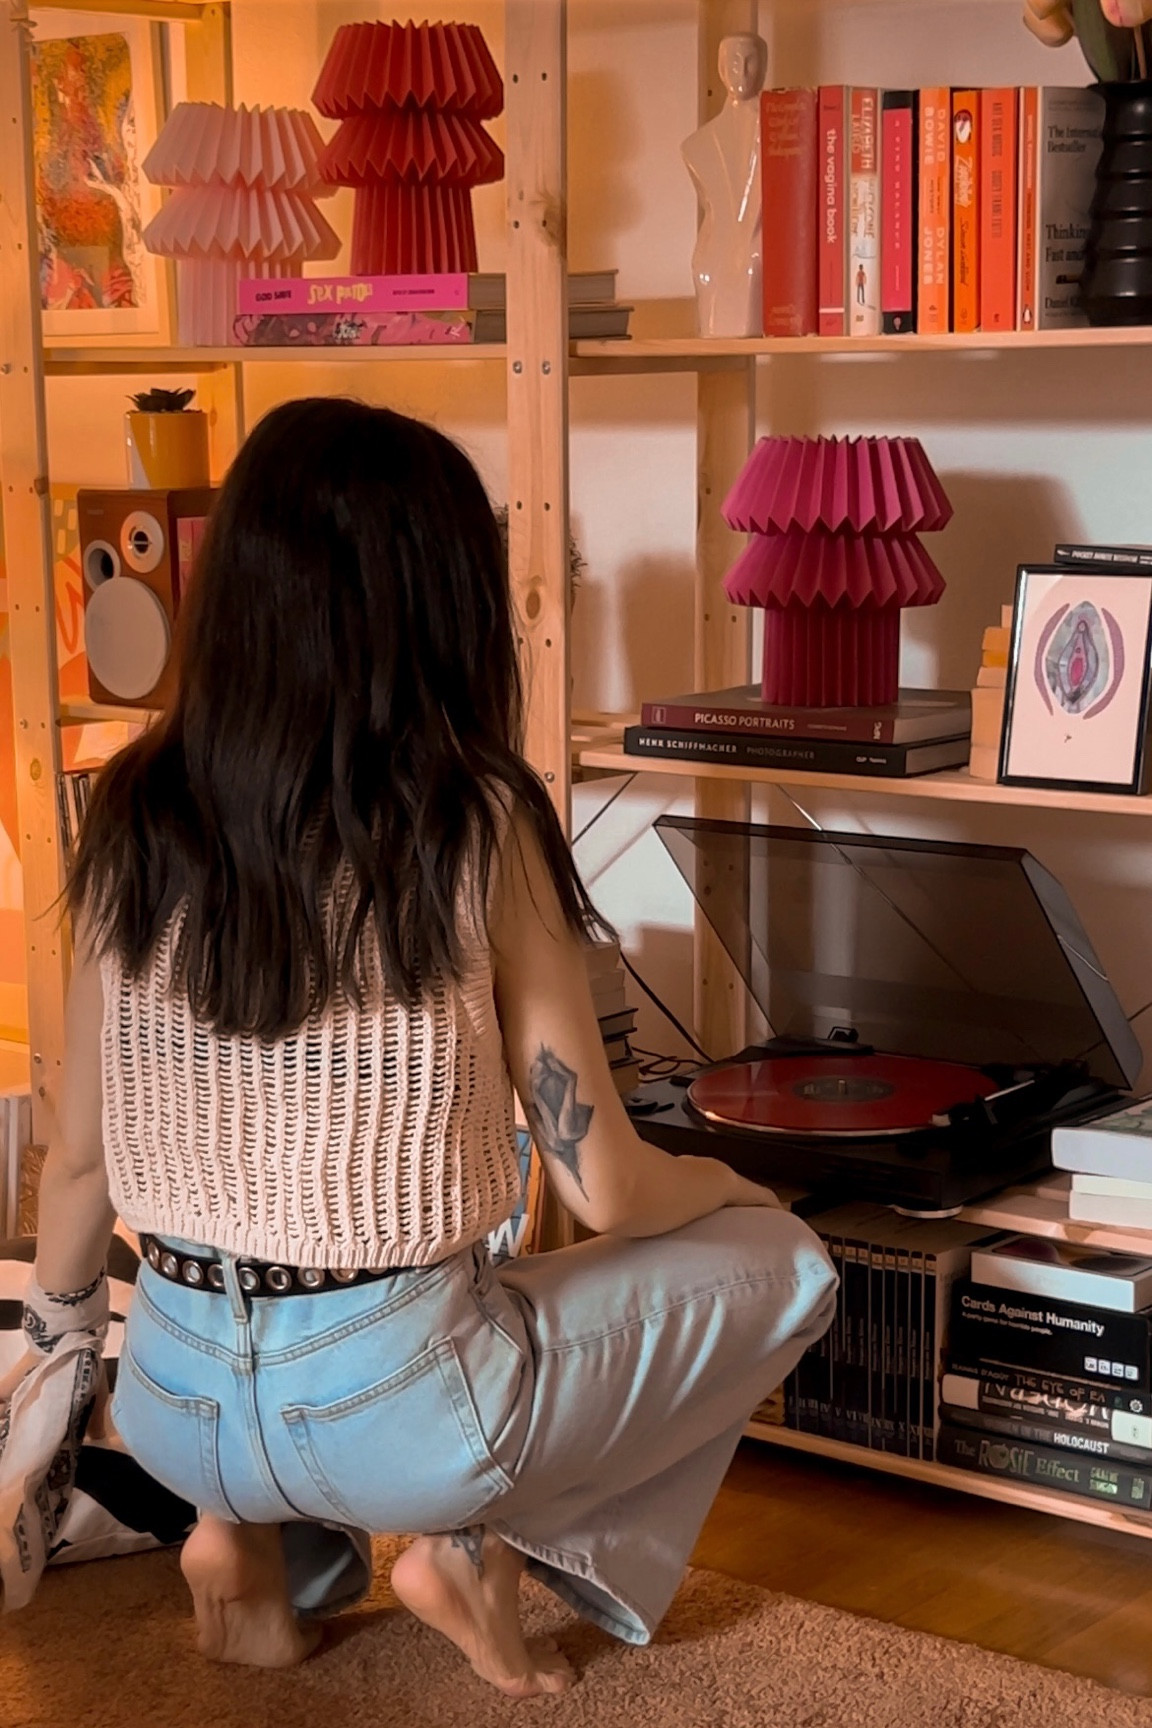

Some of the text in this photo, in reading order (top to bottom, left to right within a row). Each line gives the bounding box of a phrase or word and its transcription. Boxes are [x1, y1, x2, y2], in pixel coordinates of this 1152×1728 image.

[861, 97, 873, 169] ELIZABETH
[924, 106, 935, 165] BOWIE
[936, 109, 946, 162] DAVID
[824, 129, 837, 244] the vagina book
[923, 227, 934, 285] JONES
[936, 227, 945, 284] DYLAN
[694, 712, 737, 726] PICASSO
[738, 715, 795, 730] PORTRAITS
[639, 737, 816, 760] HENK SCHIFFMACHER PHOTOGRAPHER
[961, 1295, 1105, 1337] Cards Against Humanity
[1015, 1373, 1037, 1387] THE
[1041, 1379, 1065, 1394] EYE
[954, 1439, 976, 1458] The
[1036, 1457, 1080, 1484] Effect
[1053, 1432, 1110, 1454] HOLOCAUST
